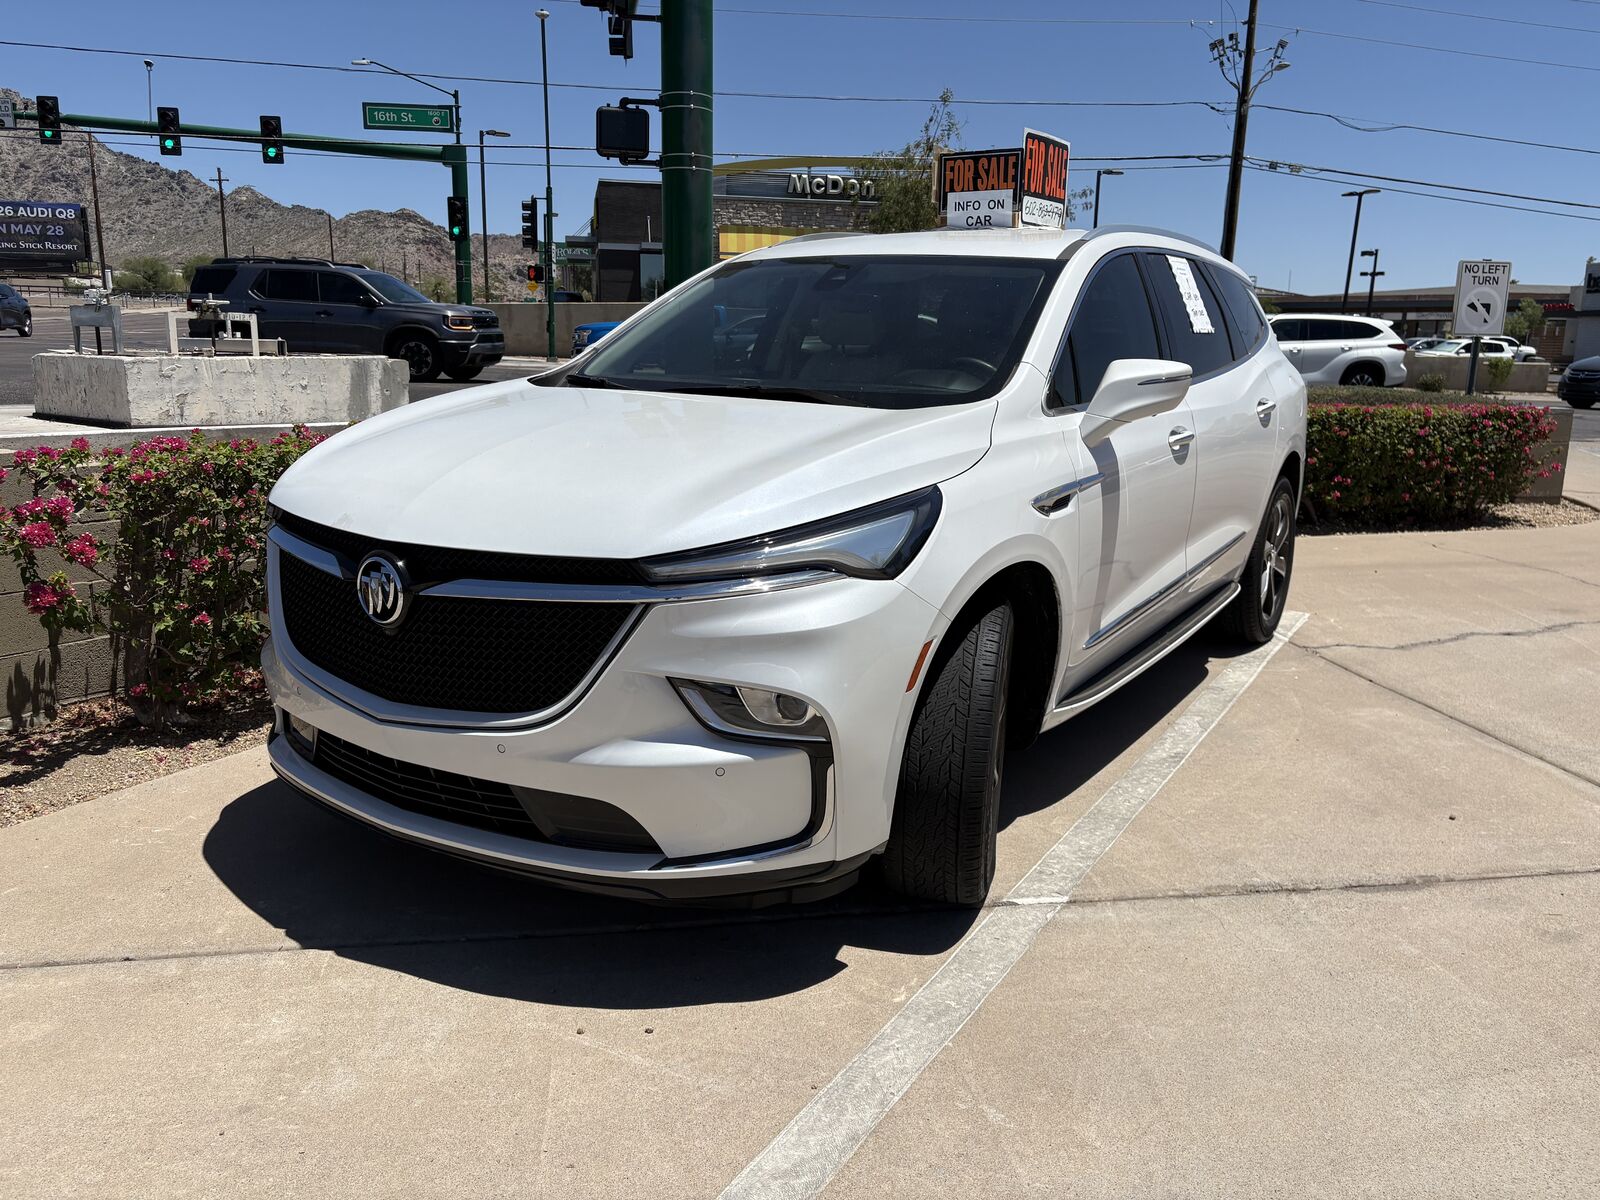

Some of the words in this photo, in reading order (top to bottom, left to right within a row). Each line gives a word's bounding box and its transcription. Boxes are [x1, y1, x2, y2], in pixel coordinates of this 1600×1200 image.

[373, 111, 397, 122] 16th
[401, 112, 416, 122] St.
[945, 159, 974, 192] FOR
[977, 156, 1017, 191] SALE
[1024, 138, 1046, 194] FOR
[1045, 143, 1068, 199] SALE
[954, 200, 981, 212] INFO
[987, 199, 1005, 210] ON
[17, 206, 52, 218] AUDI
[55, 208, 76, 219] Q8
[966, 215, 992, 227] CAR
[11, 224, 42, 235] MAY
[46, 225, 64, 236] 28
[1464, 264, 1479, 274] NO
[1482, 264, 1508, 275] LEFT
[1471, 276, 1499, 286] TURN
